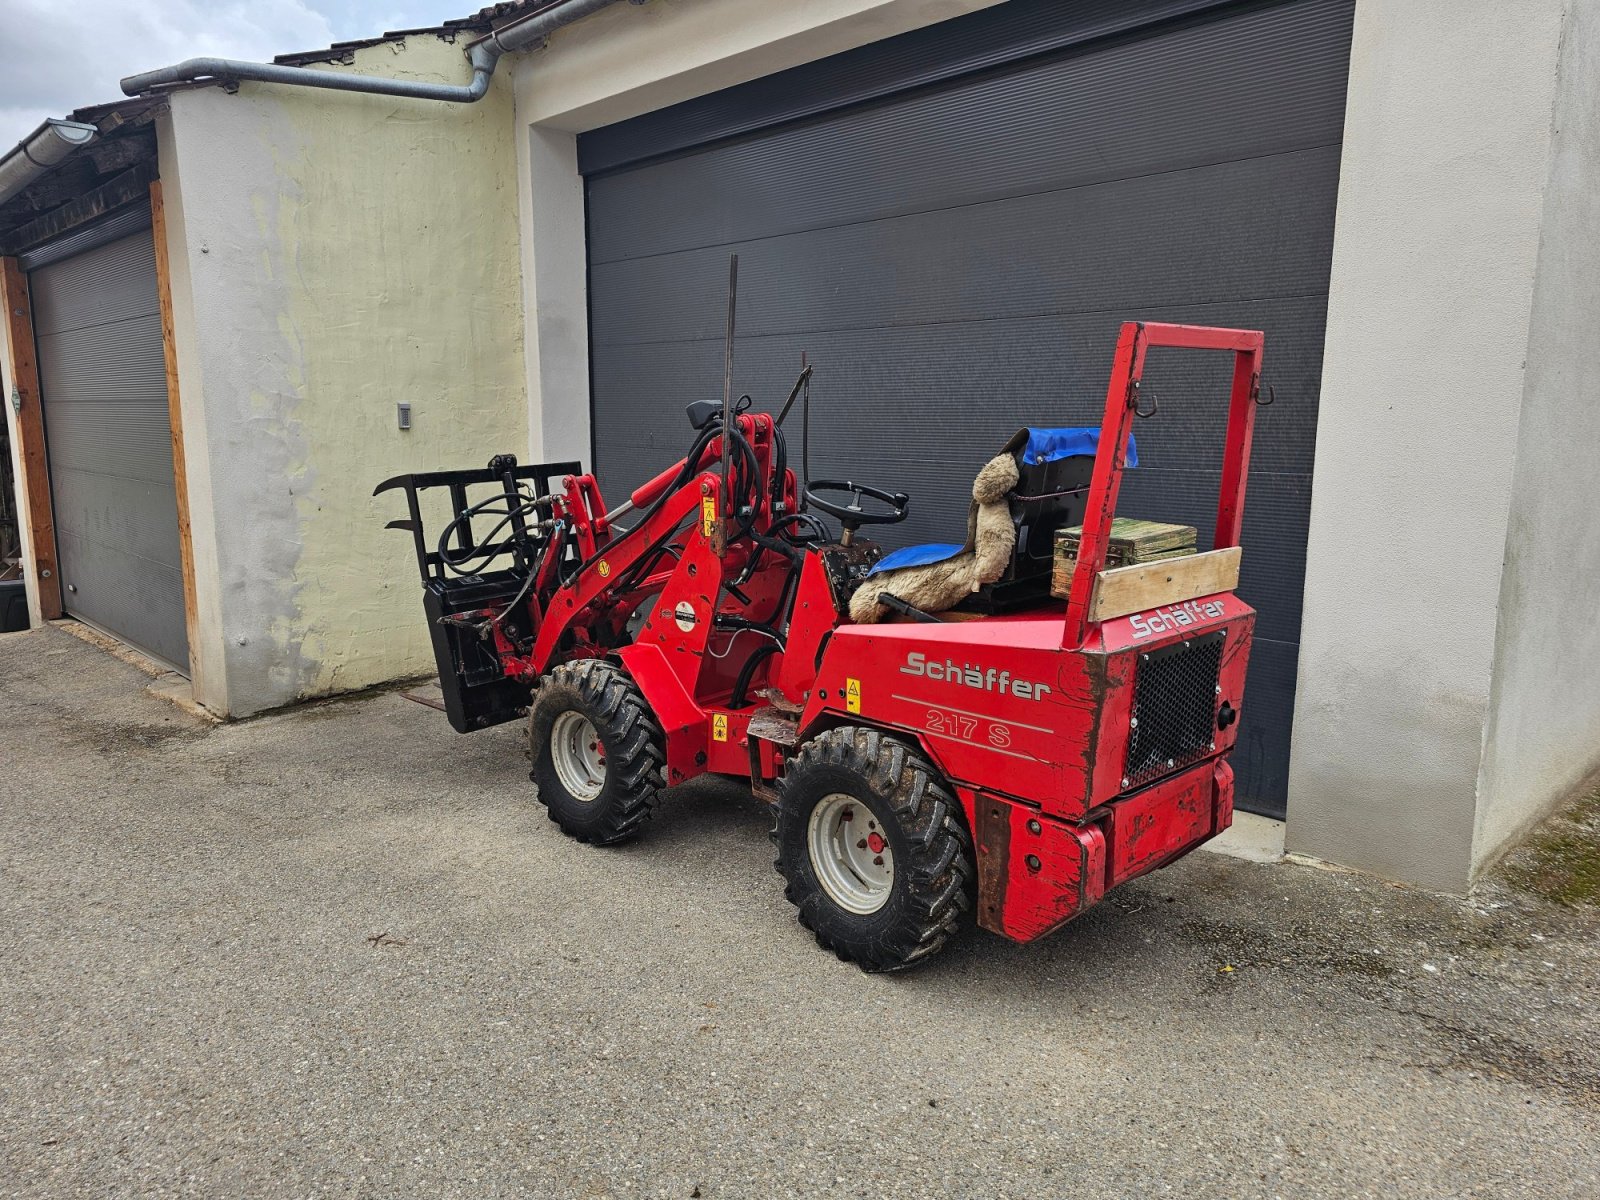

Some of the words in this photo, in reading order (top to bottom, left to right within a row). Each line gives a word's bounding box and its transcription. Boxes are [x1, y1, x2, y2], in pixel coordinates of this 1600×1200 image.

[1129, 600, 1225, 639] Schäffer
[900, 652, 1052, 701] Schäffer
[926, 710, 978, 739] 217
[988, 724, 1011, 747] S
